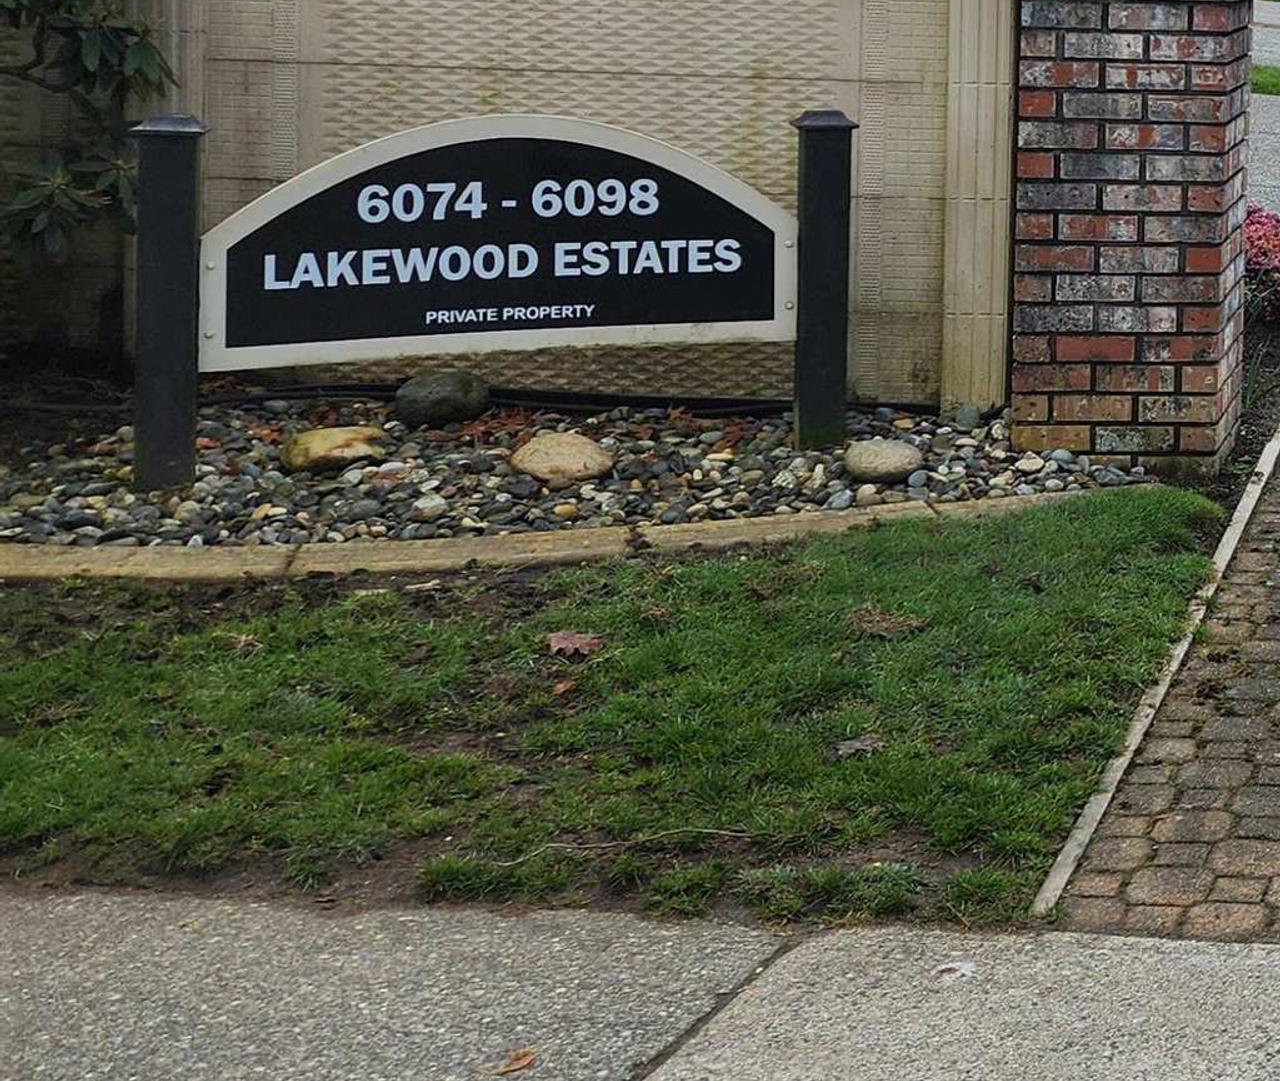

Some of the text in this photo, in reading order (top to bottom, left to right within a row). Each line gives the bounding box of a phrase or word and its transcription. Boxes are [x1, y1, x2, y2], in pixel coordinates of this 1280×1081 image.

[356, 178, 660, 224] 6074 - 6098
[263, 238, 742, 290] LAKEWOOD ESTATES
[425, 304, 596, 325] PRIVATE PROPERTY
